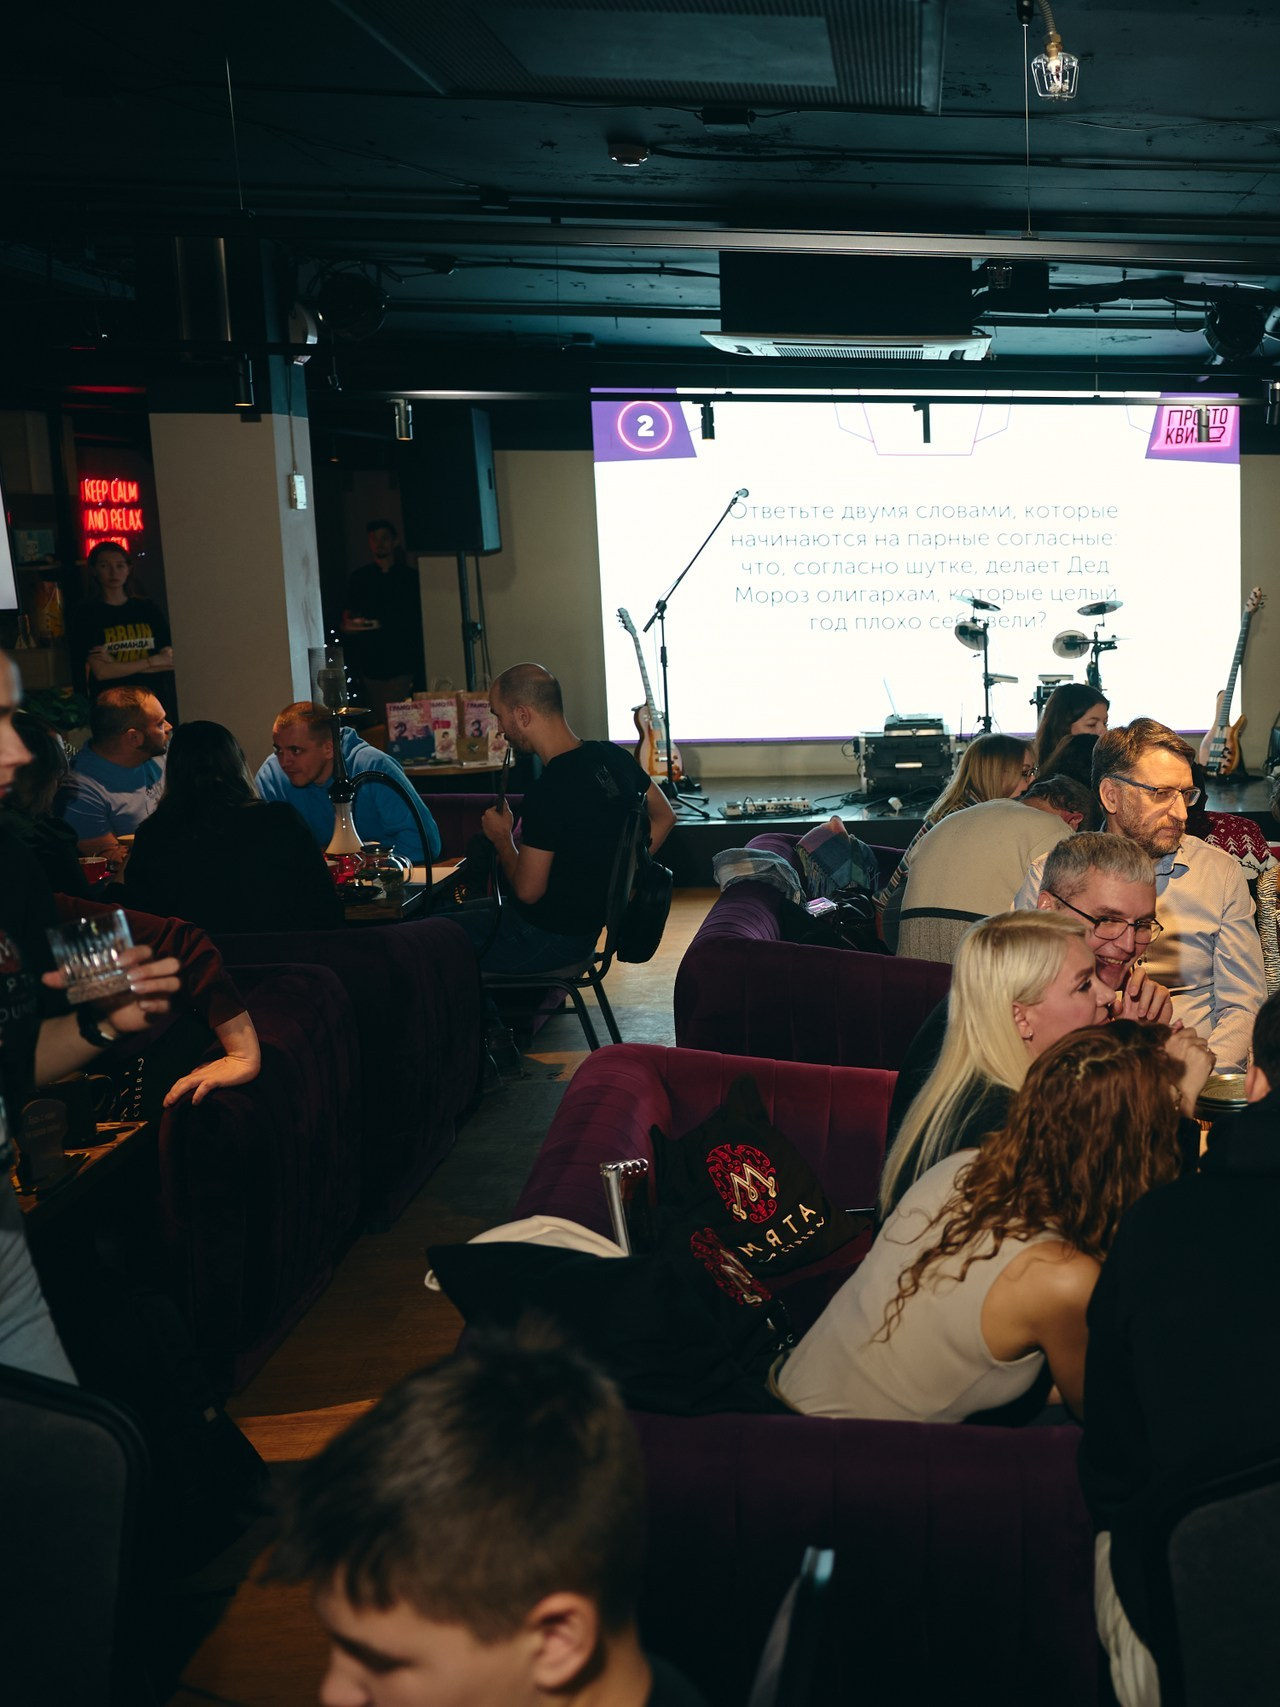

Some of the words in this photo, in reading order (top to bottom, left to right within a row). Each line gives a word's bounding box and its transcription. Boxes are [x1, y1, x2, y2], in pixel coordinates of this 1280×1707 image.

[637, 414, 655, 437] 2
[1167, 408, 1229, 426] ПРОТО
[1165, 427, 1198, 444] КВИ
[84, 480, 109, 502] KEEP
[110, 481, 139, 503] CALM
[88, 508, 109, 531] AND
[110, 508, 144, 531] RELAX
[729, 501, 834, 519] Ответьте
[841, 505, 908, 523] двумя
[916, 505, 1016, 519] словами,
[1025, 505, 1118, 522] которые
[731, 533, 866, 547] начинаются
[875, 533, 899, 547] на
[908, 533, 989, 550] парные
[741, 562, 785, 576] что,
[794, 561, 898, 575] согласно
[906, 561, 978, 578] шутке,
[986, 561, 1060, 575] делает
[1067, 556, 1110, 575] Дед
[735, 586, 809, 607] Мороз
[817, 589, 940, 606] олигархам,
[1051, 585, 1117, 602] целый
[810, 617, 848, 632] год
[855, 617, 921, 630] плохо
[986, 611, 1047, 629] вели?
